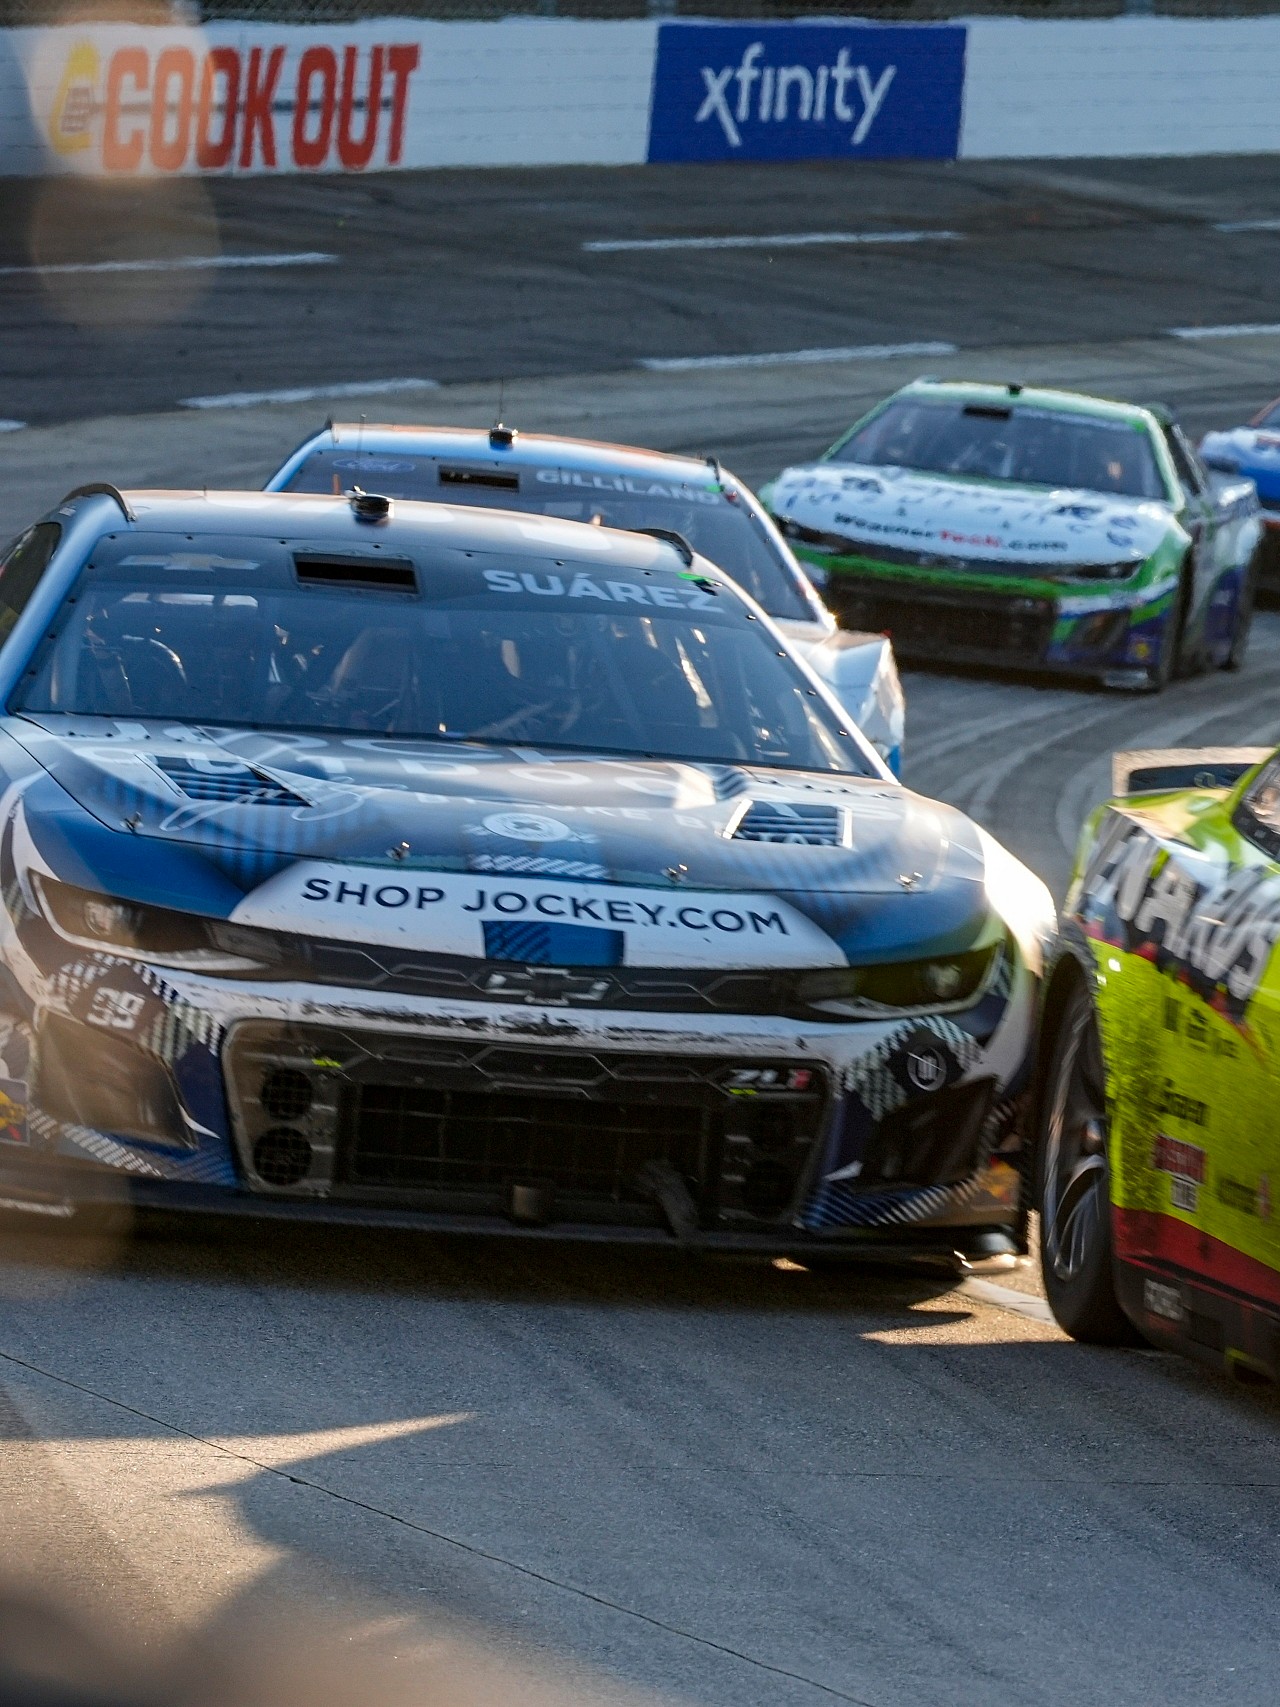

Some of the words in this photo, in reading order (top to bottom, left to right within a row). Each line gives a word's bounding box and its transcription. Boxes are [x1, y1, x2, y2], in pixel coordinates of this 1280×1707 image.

[103, 43, 287, 172] COOK
[291, 42, 422, 170] OUT
[696, 42, 896, 148] xfinity
[535, 469, 722, 505] GILLILAND
[482, 569, 726, 614] SUÁREZ
[303, 878, 445, 910] SHOP
[462, 889, 789, 936] JOCKEY.COM
